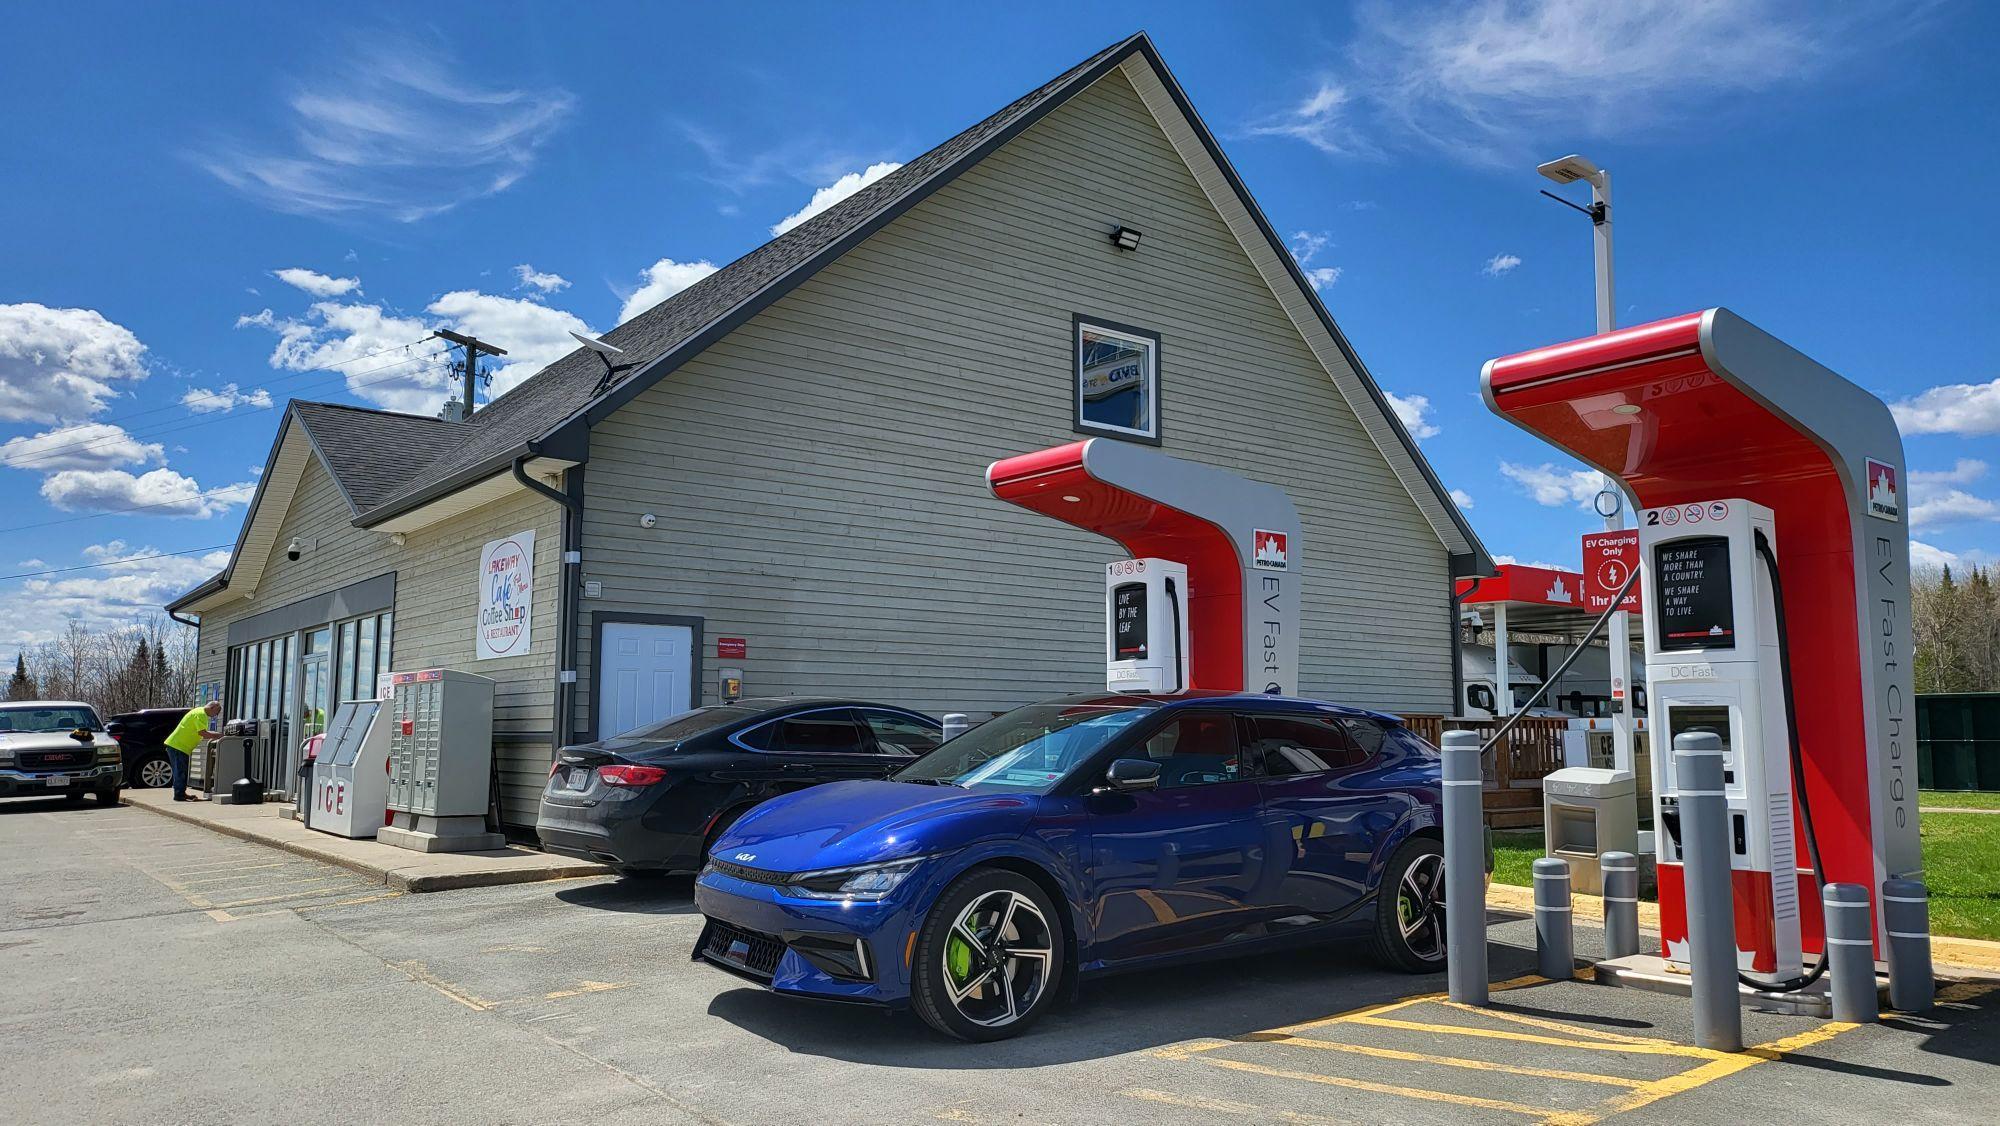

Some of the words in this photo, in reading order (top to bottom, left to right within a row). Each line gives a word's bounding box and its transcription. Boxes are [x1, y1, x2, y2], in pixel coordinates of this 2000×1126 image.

[1647, 511, 1660, 526] 2
[1586, 540, 1597, 548] EV
[1598, 536, 1637, 547] Charging
[1602, 547, 1623, 556] Only
[1662, 552, 1673, 561] WE
[1675, 550, 1698, 560] SHARE
[489, 554, 520, 574] LAKEWAY
[1257, 560, 1287, 568] PETRO-CANADA
[1663, 561, 1683, 571] MORE
[1685, 560, 1704, 570] THAN
[1876, 537, 1894, 586] EV
[1109, 566, 1113, 576] 1
[1664, 573, 1669, 582] A
[1671, 570, 1705, 581] COUNTRY.
[491, 571, 514, 609] Café
[1262, 577, 1280, 613] EV
[1664, 586, 1674, 596] WE
[1677, 584, 1700, 596] SHARE
[1118, 593, 1130, 606] LIVE
[1591, 595, 1609, 606] 1hr
[1665, 597, 1670, 606] A
[1672, 596, 1688, 606] WAY
[482, 606, 503, 626] Coffee
[504, 604, 526, 625] Shop
[1118, 608, 1127, 619] BY
[1127, 606, 1138, 618] THE
[1666, 607, 1675, 616] TO
[1677, 606, 1695, 616] LIVE.
[491, 625, 519, 638] RESTAURANT
[1118, 621, 1132, 634] LEAF
[1881, 598, 1898, 673] Fast
[1263, 621, 1281, 673] Fast
[1116, 670, 1126, 679] DC
[1126, 670, 1138, 679] Fast
[1671, 666, 1689, 678] DC
[1691, 665, 1715, 678] Fast
[380, 687, 391, 698] ICE
[1887, 684, 1906, 829] Charge
[317, 779, 345, 816] ICE
